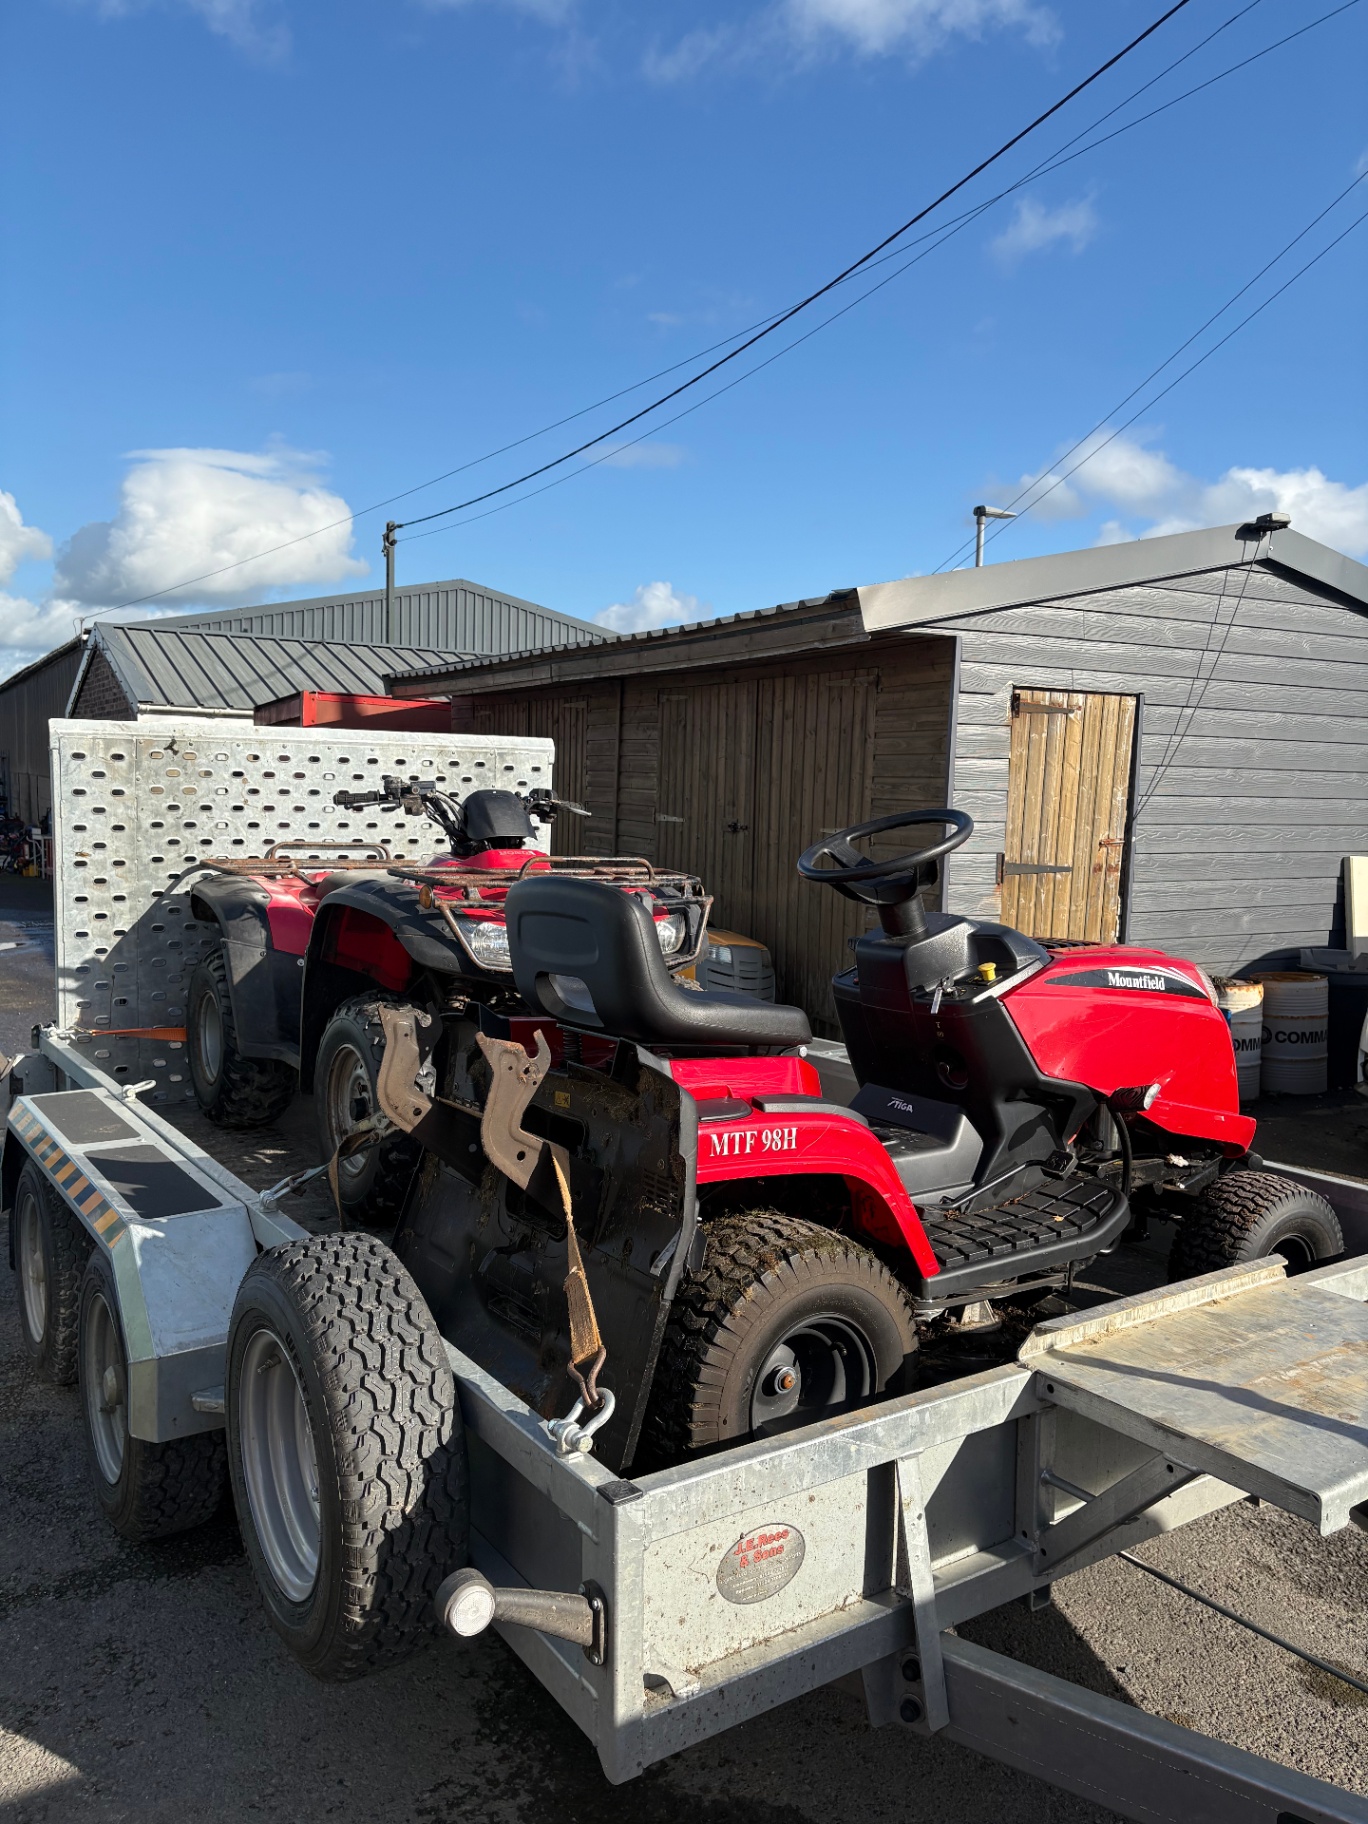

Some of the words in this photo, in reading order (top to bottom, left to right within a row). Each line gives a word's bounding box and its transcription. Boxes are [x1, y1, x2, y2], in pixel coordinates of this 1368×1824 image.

[1107, 971, 1166, 991] Mountfield
[887, 1096, 914, 1114] STIGA
[709, 1130, 758, 1157] MTF
[761, 1127, 799, 1153] 98H
[739, 1554, 749, 1569] &
[753, 1543, 785, 1564] Sons
